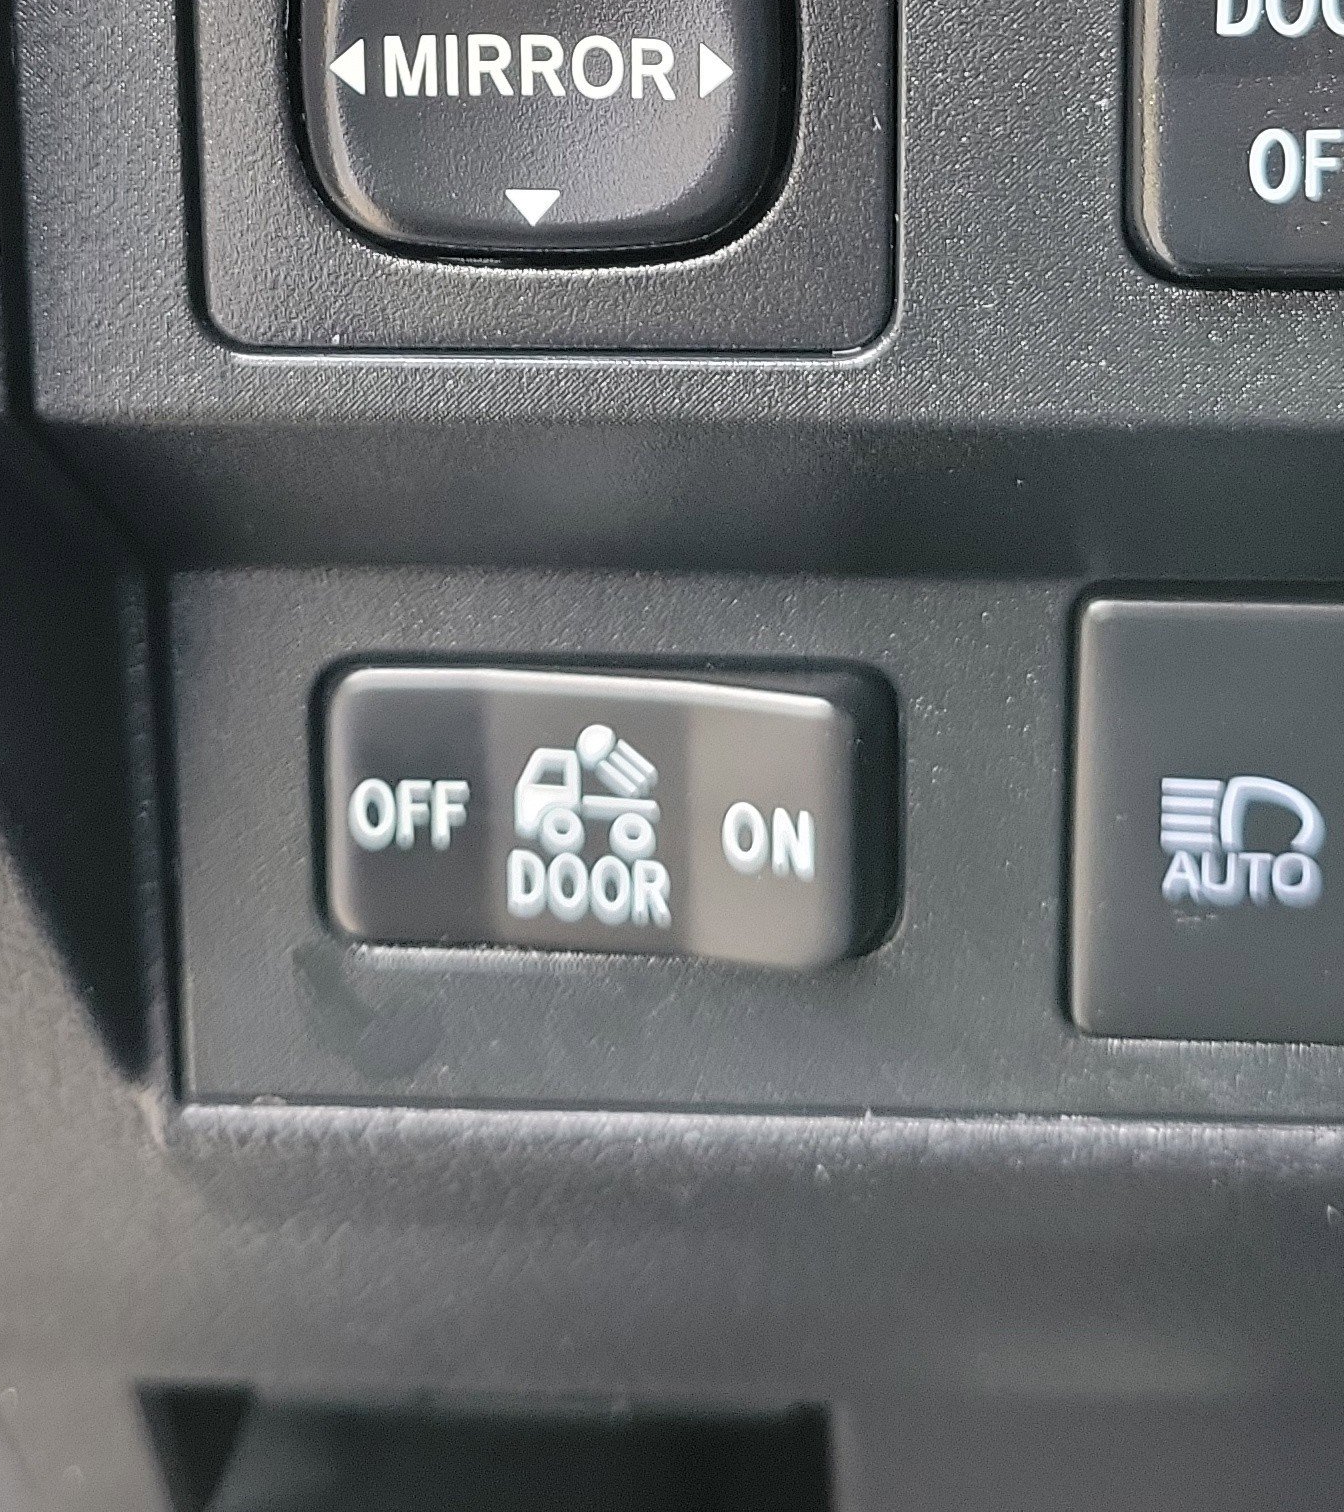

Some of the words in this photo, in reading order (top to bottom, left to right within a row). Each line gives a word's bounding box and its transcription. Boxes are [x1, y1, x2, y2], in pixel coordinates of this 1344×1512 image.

[382, 33, 677, 103] MIRROR
[348, 777, 471, 852] OFF
[720, 800, 817, 883] ON
[505, 848, 673, 931] DOOR
[1161, 849, 1326, 909] AUTO
